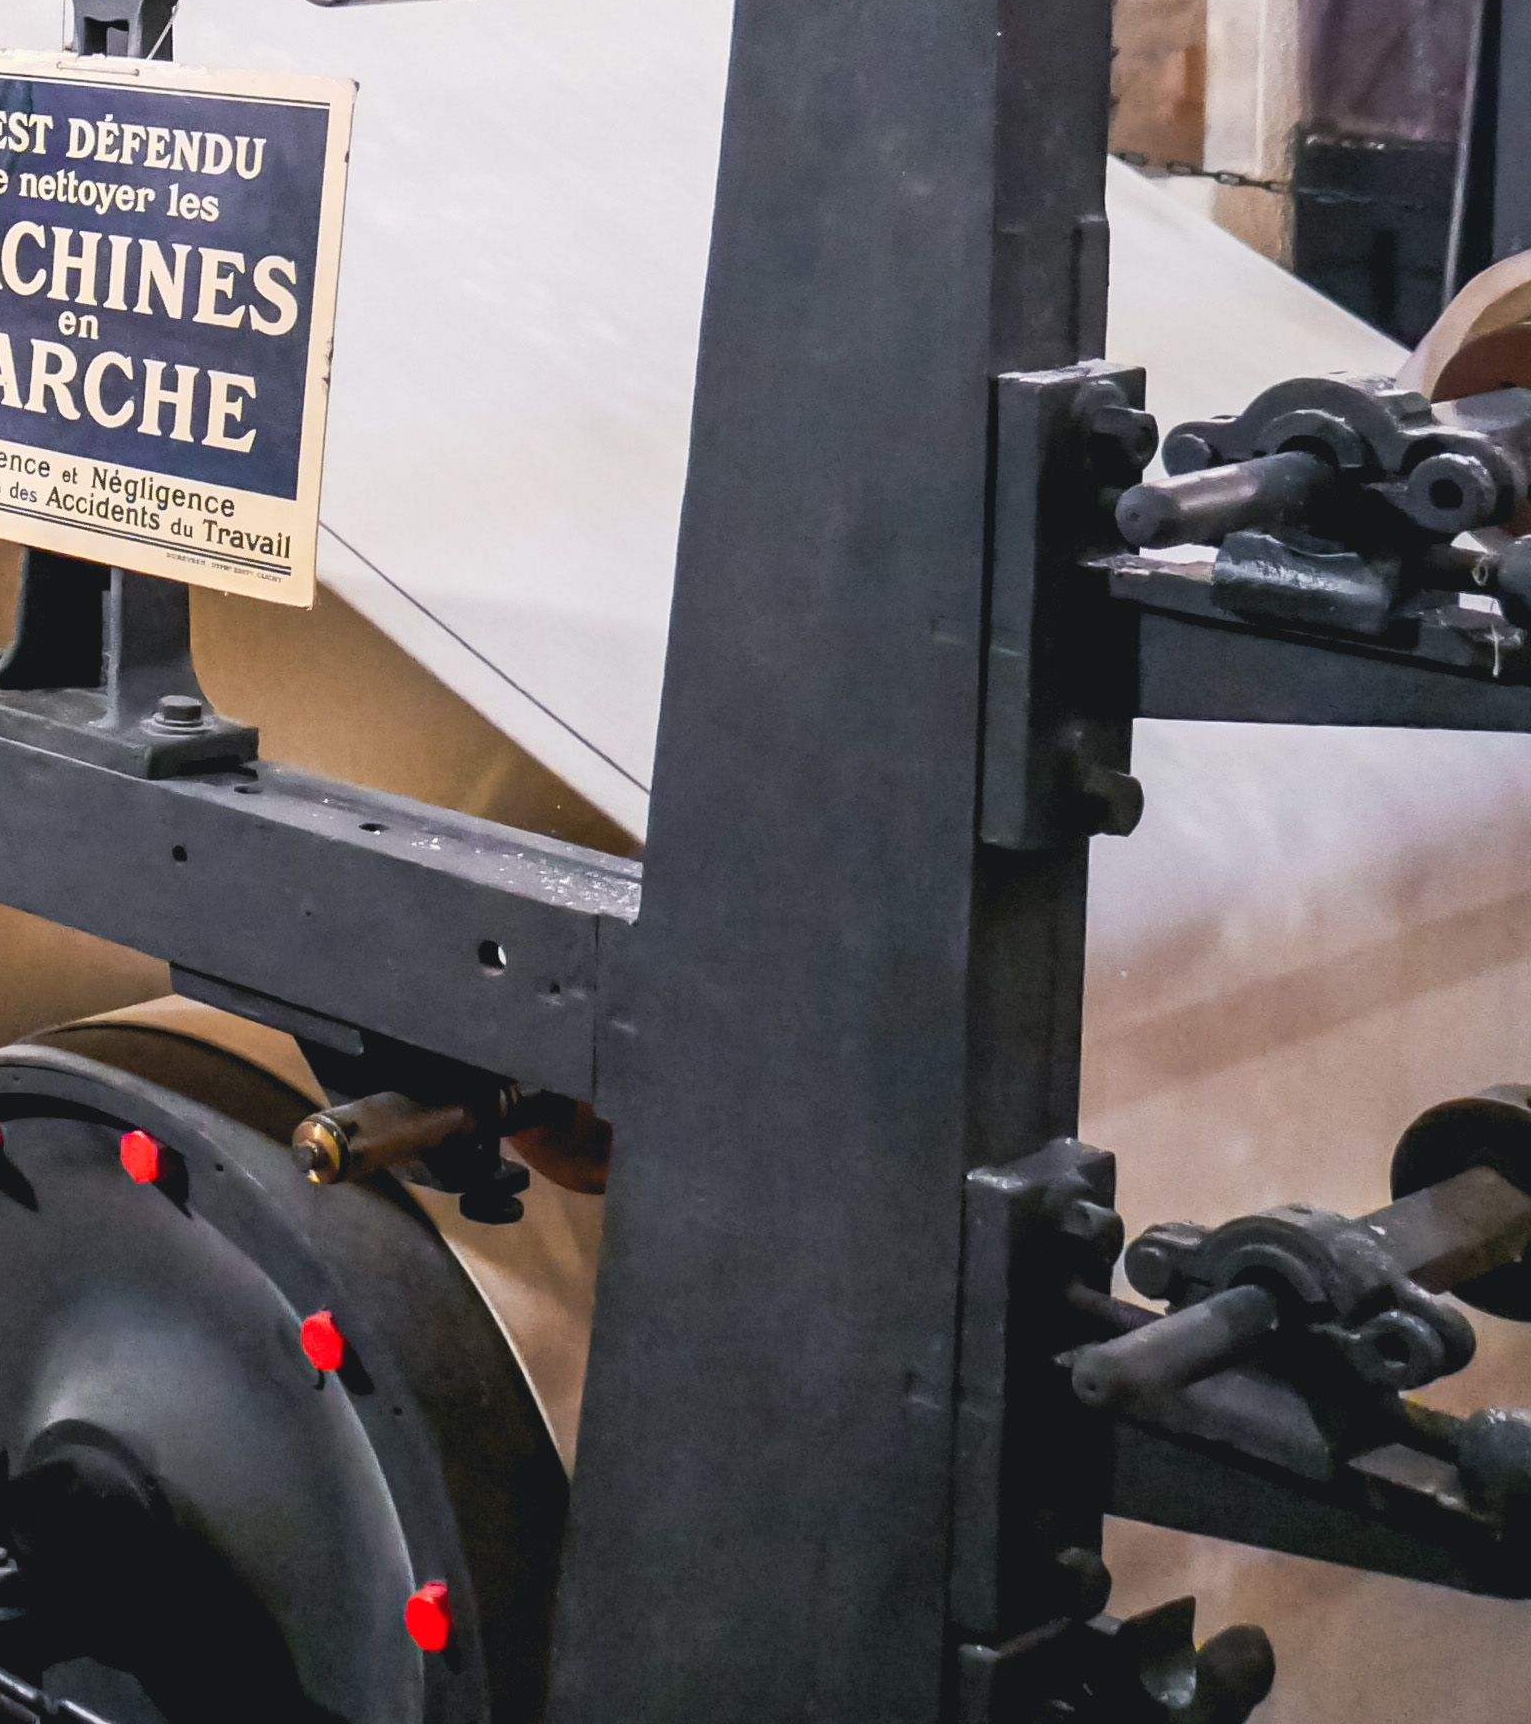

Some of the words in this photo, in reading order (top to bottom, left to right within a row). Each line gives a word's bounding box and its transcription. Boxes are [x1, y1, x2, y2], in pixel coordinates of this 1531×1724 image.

[66, 114, 266, 180] DÉFENDU
[19, 171, 156, 214] nettoyer
[167, 184, 219, 222] les
[59, 310, 98, 339] en
[62, 466, 78, 484] et
[92, 466, 236, 518] Négligence
[10, 479, 37, 504] des
[45, 485, 160, 532] Accidents
[171, 517, 194, 538] du
[203, 519, 291, 559] Travail
